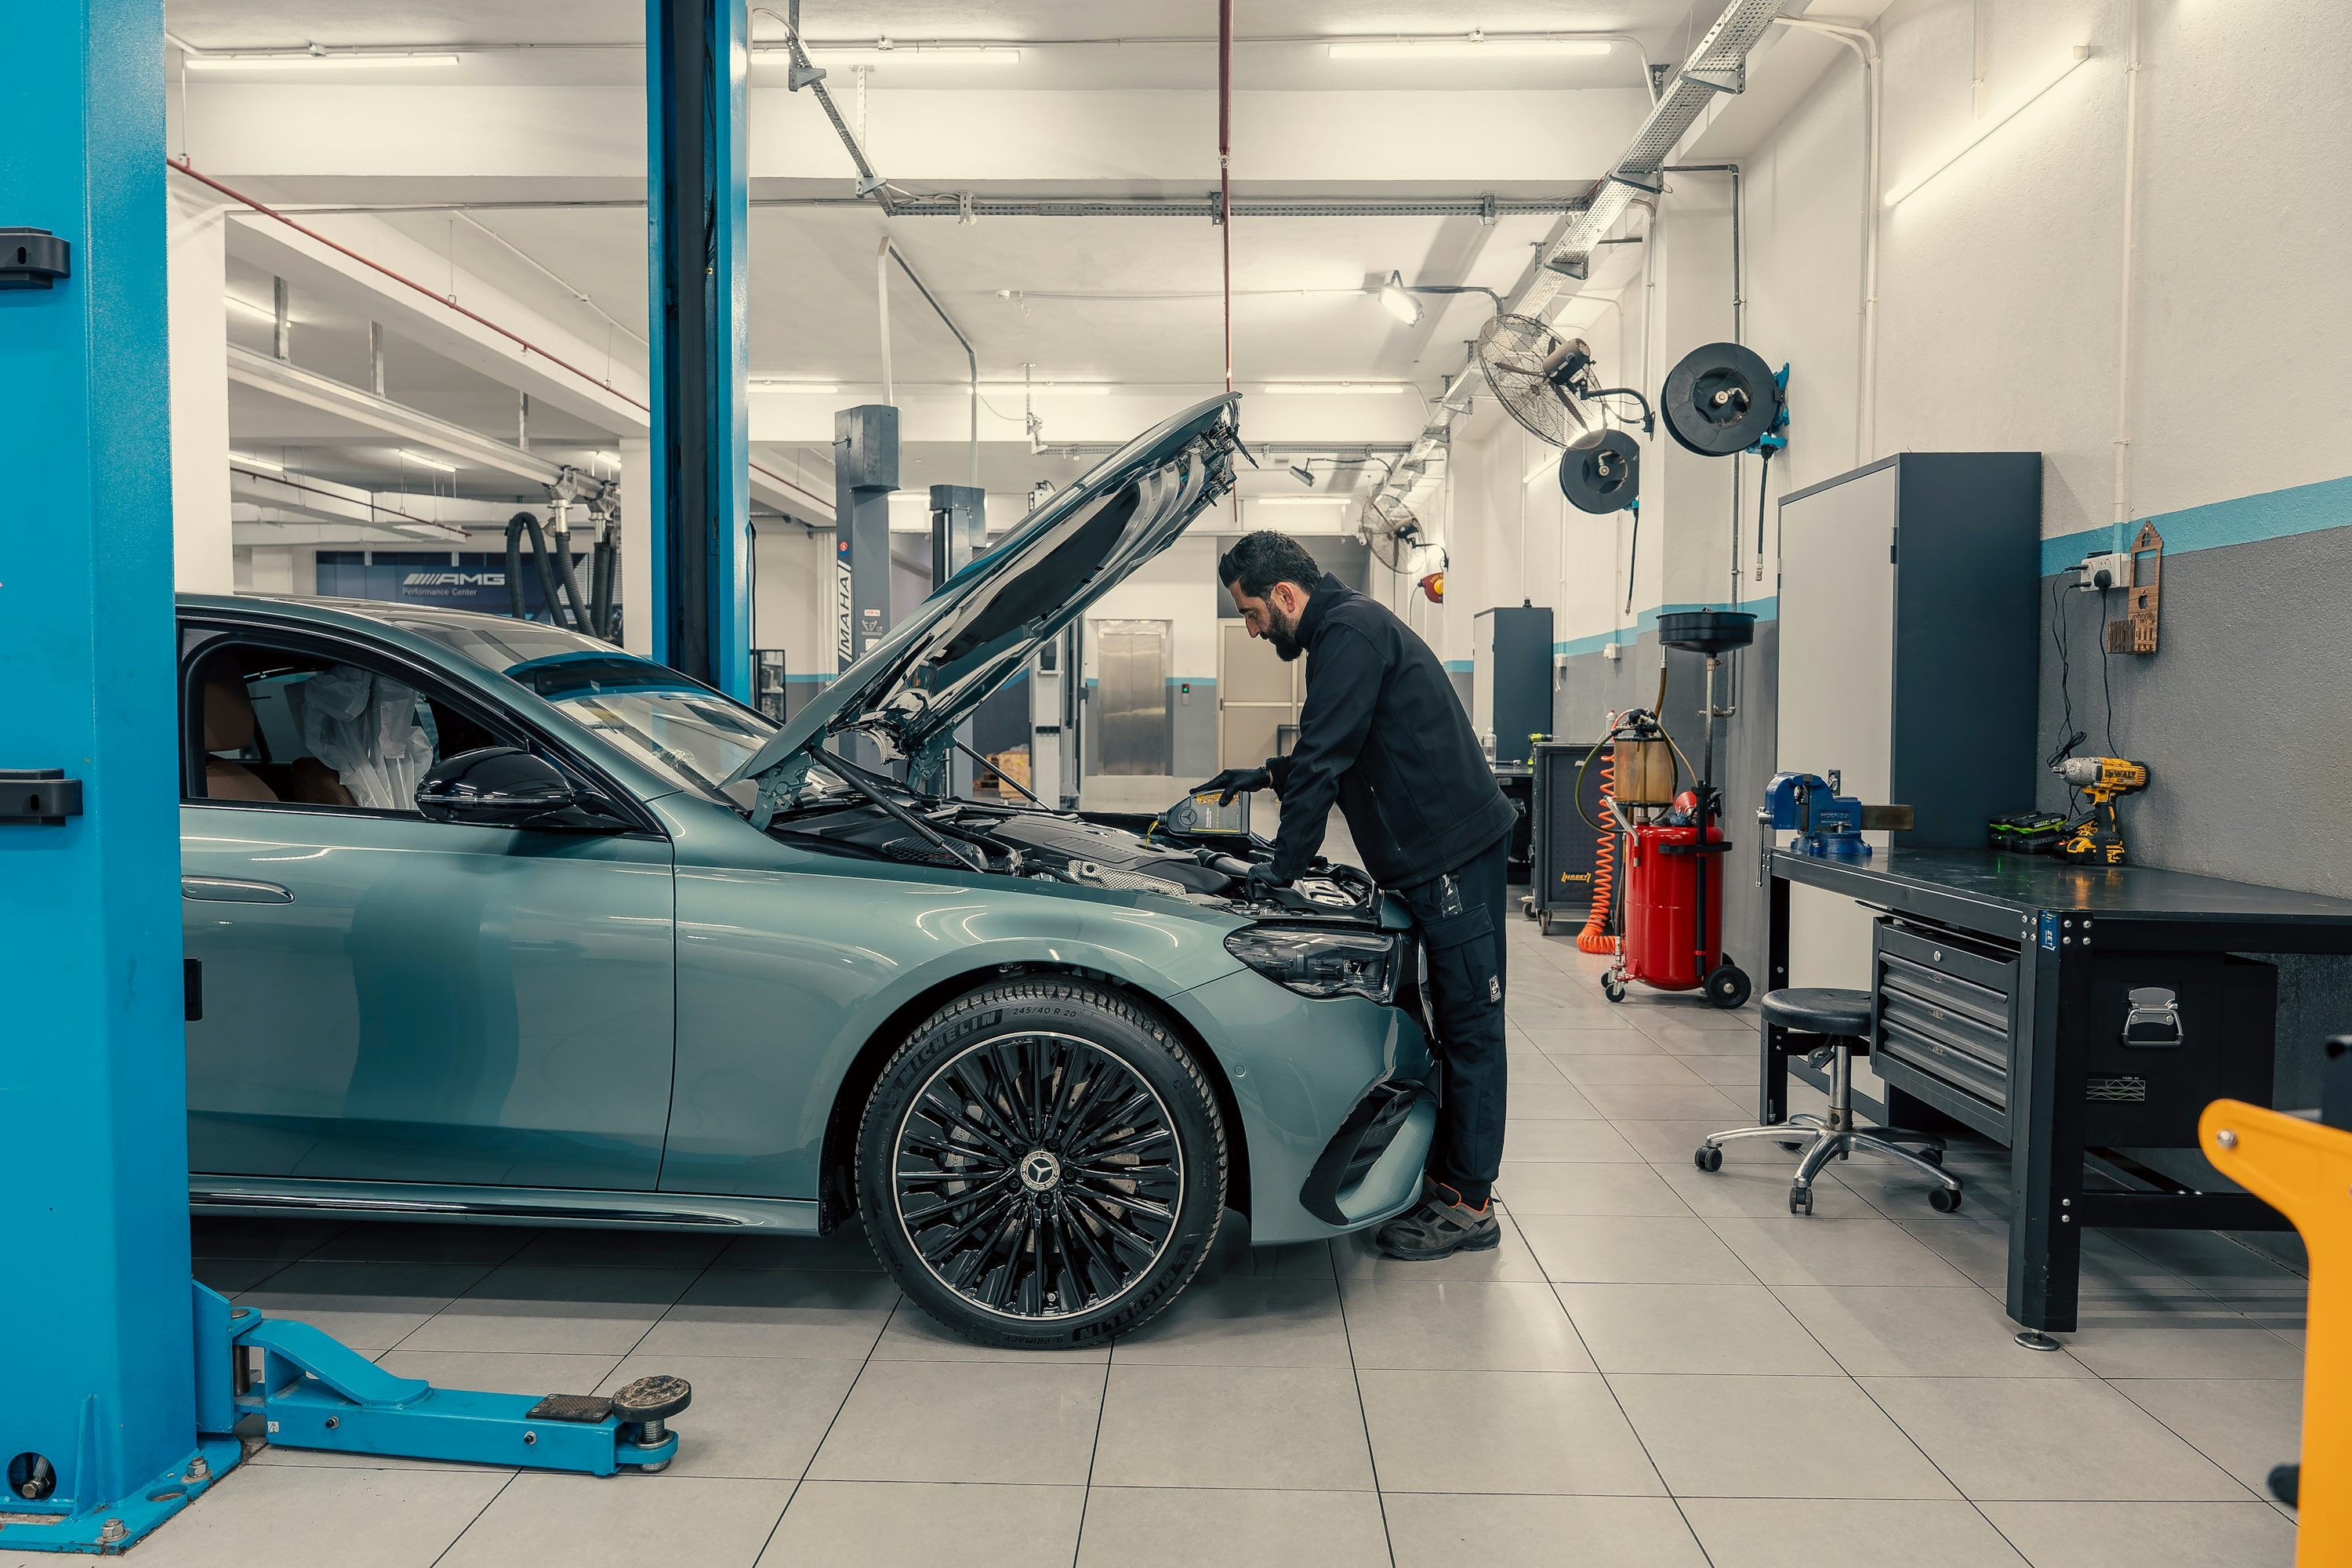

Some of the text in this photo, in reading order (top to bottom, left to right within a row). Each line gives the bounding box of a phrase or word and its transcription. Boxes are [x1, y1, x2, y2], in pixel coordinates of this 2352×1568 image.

[436, 573, 506, 586] AMG
[840, 576, 850, 650] MAHA
[1563, 873, 1590, 881] HAZET
[1012, 1007, 1051, 1016] 245/40
[1064, 1009, 1077, 1018] 20
[902, 1011, 996, 1081] MICHELIN
[1079, 1267, 1177, 1340] MICHELIN
